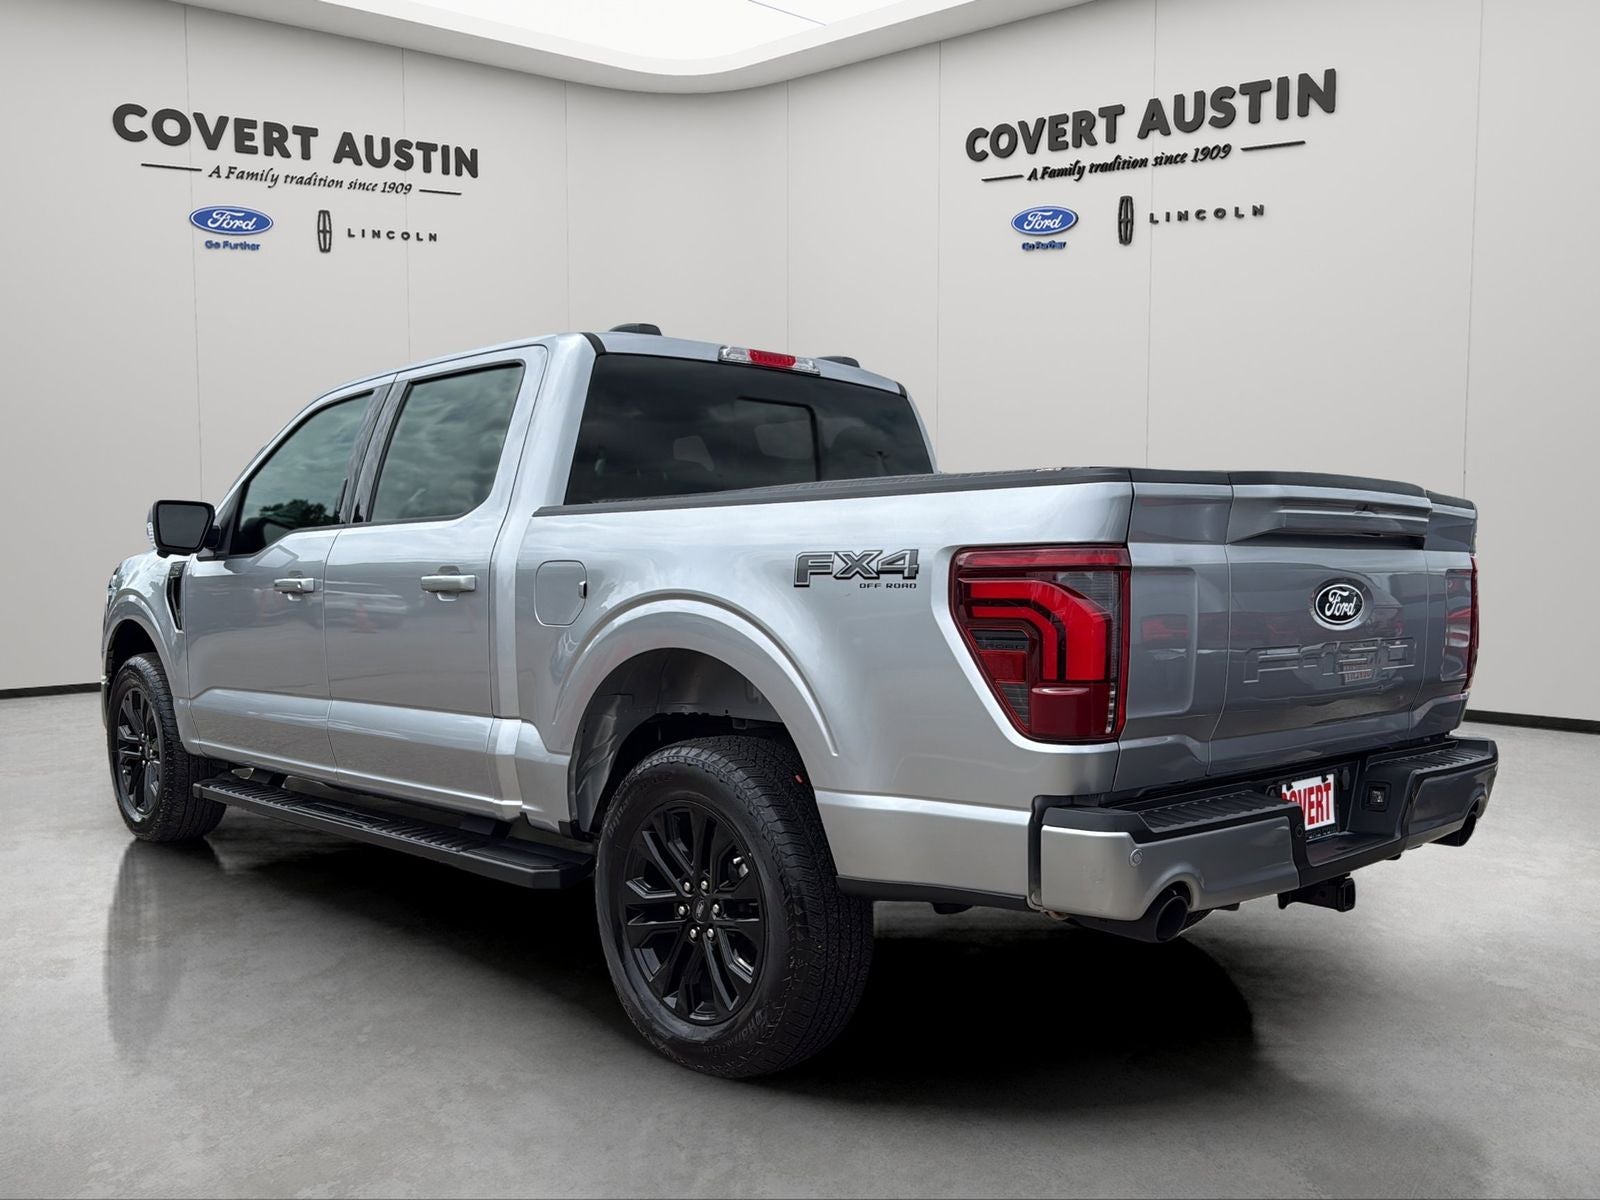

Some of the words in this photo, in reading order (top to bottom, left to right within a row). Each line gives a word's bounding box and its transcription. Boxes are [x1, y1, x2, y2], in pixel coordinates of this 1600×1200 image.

[966, 104, 1126, 163] COVERT
[1137, 68, 1337, 140] AUSTIN
[112, 103, 319, 161] COVERT
[333, 131, 479, 179] AUSTIN
[1027, 168, 1039, 182] A
[1040, 159, 1086, 182] Family
[1088, 154, 1149, 175] tradition
[1151, 152, 1188, 168] since
[1190, 143, 1232, 163] 1909
[208, 164, 222, 179] A
[224, 165, 280, 189] Family
[283, 172, 344, 189] tradition
[347, 178, 379, 192] since
[380, 181, 413, 195] 1909
[207, 209, 257, 230] Ford
[1023, 211, 1063, 230] Ford
[1149, 204, 1265, 225] LINCOLN
[347, 227, 437, 243] LINCOLN
[794, 549, 919, 587] FX4
[1325, 589, 1357, 617] Ford
